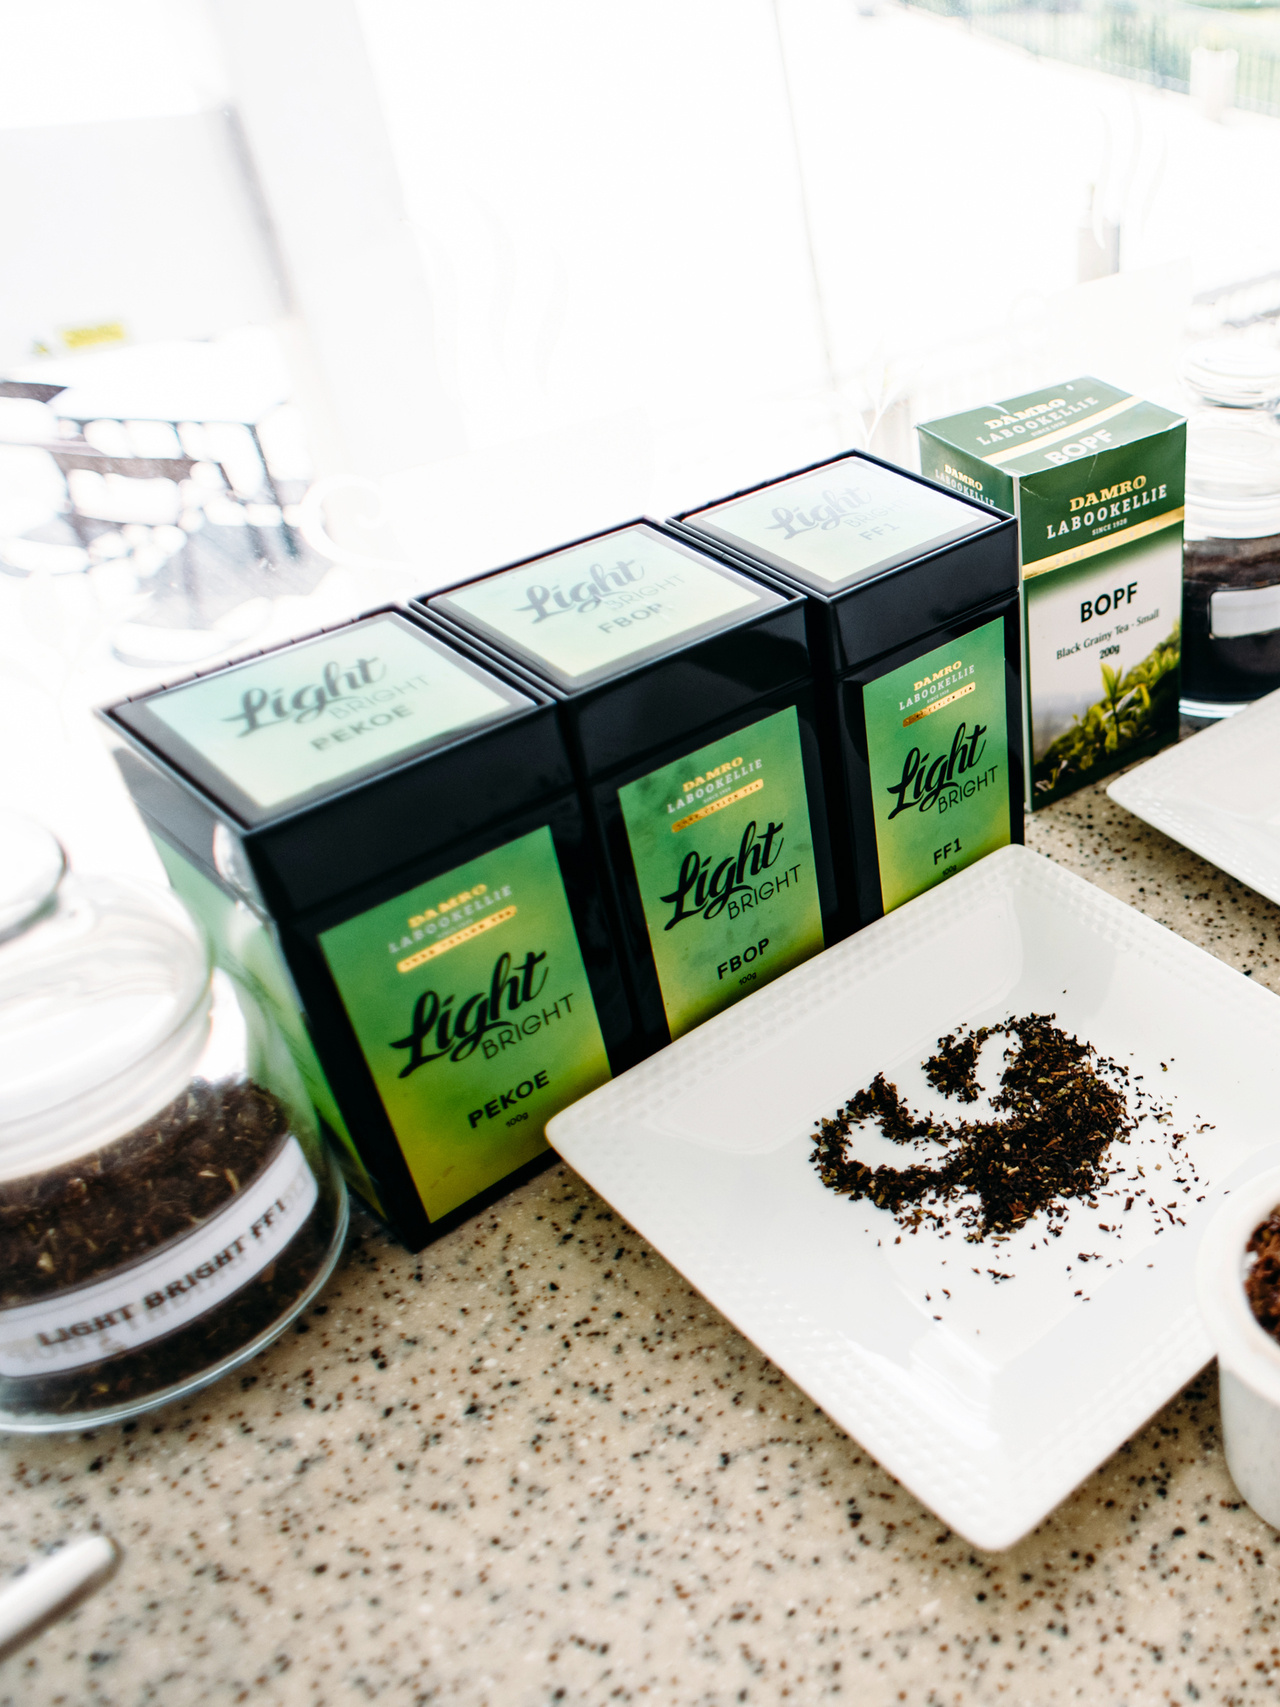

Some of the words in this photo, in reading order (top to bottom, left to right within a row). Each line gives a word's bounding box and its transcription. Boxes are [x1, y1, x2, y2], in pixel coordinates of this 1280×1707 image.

[976, 397, 1099, 446] LABOOKELLIE
[984, 398, 1067, 430] DAMRO
[1044, 429, 1113, 465] BOPF
[944, 464, 983, 491] DAMRO
[1069, 475, 1147, 512] DAMRO
[765, 487, 872, 540] Light
[859, 522, 900, 541] FF1
[1047, 484, 1168, 539] LABOOKELLIE
[1092, 523, 1111, 536] SINCE
[514, 559, 645, 625] Light
[604, 574, 685, 610] BRIGHT
[1080, 582, 1138, 623] BOPF
[598, 603, 663, 634] FBOP
[1056, 642, 1081, 660] Black
[1083, 630, 1113, 649] Grainy
[1115, 623, 1129, 637] Tea
[1136, 608, 1160, 626] Small
[1099, 644, 1120, 660] 200g
[221, 657, 387, 738] Light
[328, 674, 430, 720] BRIGHT
[899, 665, 975, 711] LABOOKELLIE
[914, 660, 962, 691] DAMRO
[310, 704, 414, 751] PEKOE
[667, 759, 763, 814] LABOOKELLIE
[682, 756, 743, 792] DAMRO
[886, 722, 988, 820] Light
[938, 765, 999, 814] BRIGHT
[933, 838, 963, 865] FF1
[659, 820, 785, 931] Light
[727, 864, 801, 920] BRIGHT
[388, 885, 512, 953] LABOOKELLIE
[408, 883, 487, 928] DAMRO
[716, 938, 770, 980] FBOP
[738, 972, 758, 985] 100g
[389, 951, 549, 1079] Light
[481, 993, 574, 1060] BRIGHT
[467, 1069, 550, 1129] PEKOE
[505, 1112, 528, 1127] 100g
[35, 1302, 138, 1347] LIGHT
[141, 1234, 248, 1312] BRIGHT
